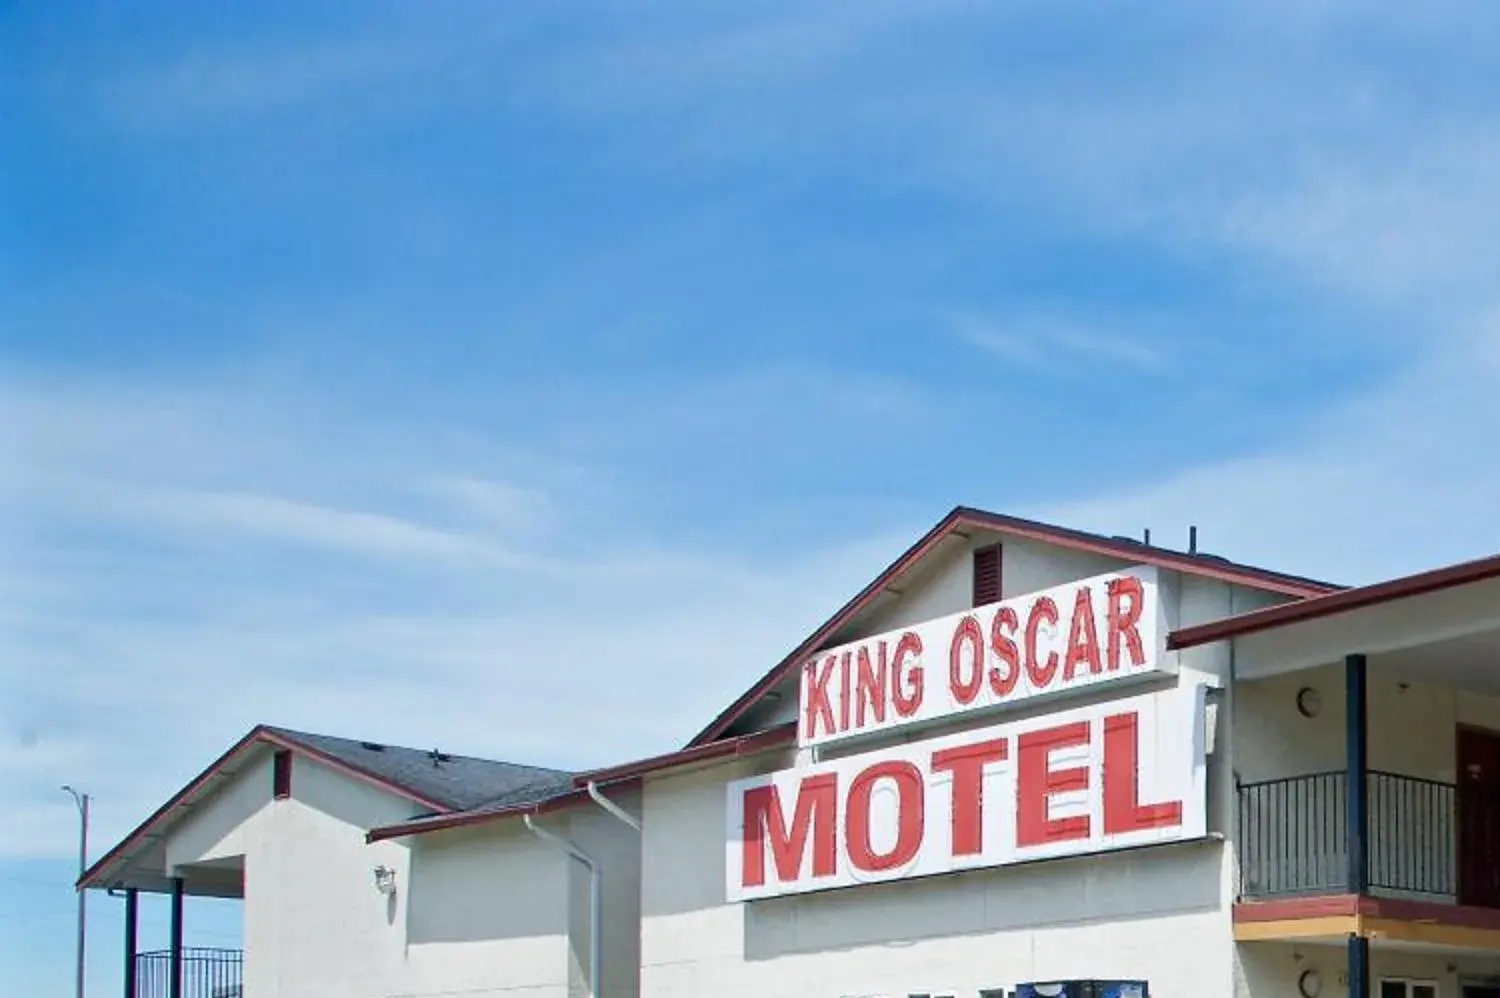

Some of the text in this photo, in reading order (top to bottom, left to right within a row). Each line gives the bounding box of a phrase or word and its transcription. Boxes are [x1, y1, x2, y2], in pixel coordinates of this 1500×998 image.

[803, 575, 1146, 739] KING OSCAR
[741, 711, 1183, 888] MOTEL
